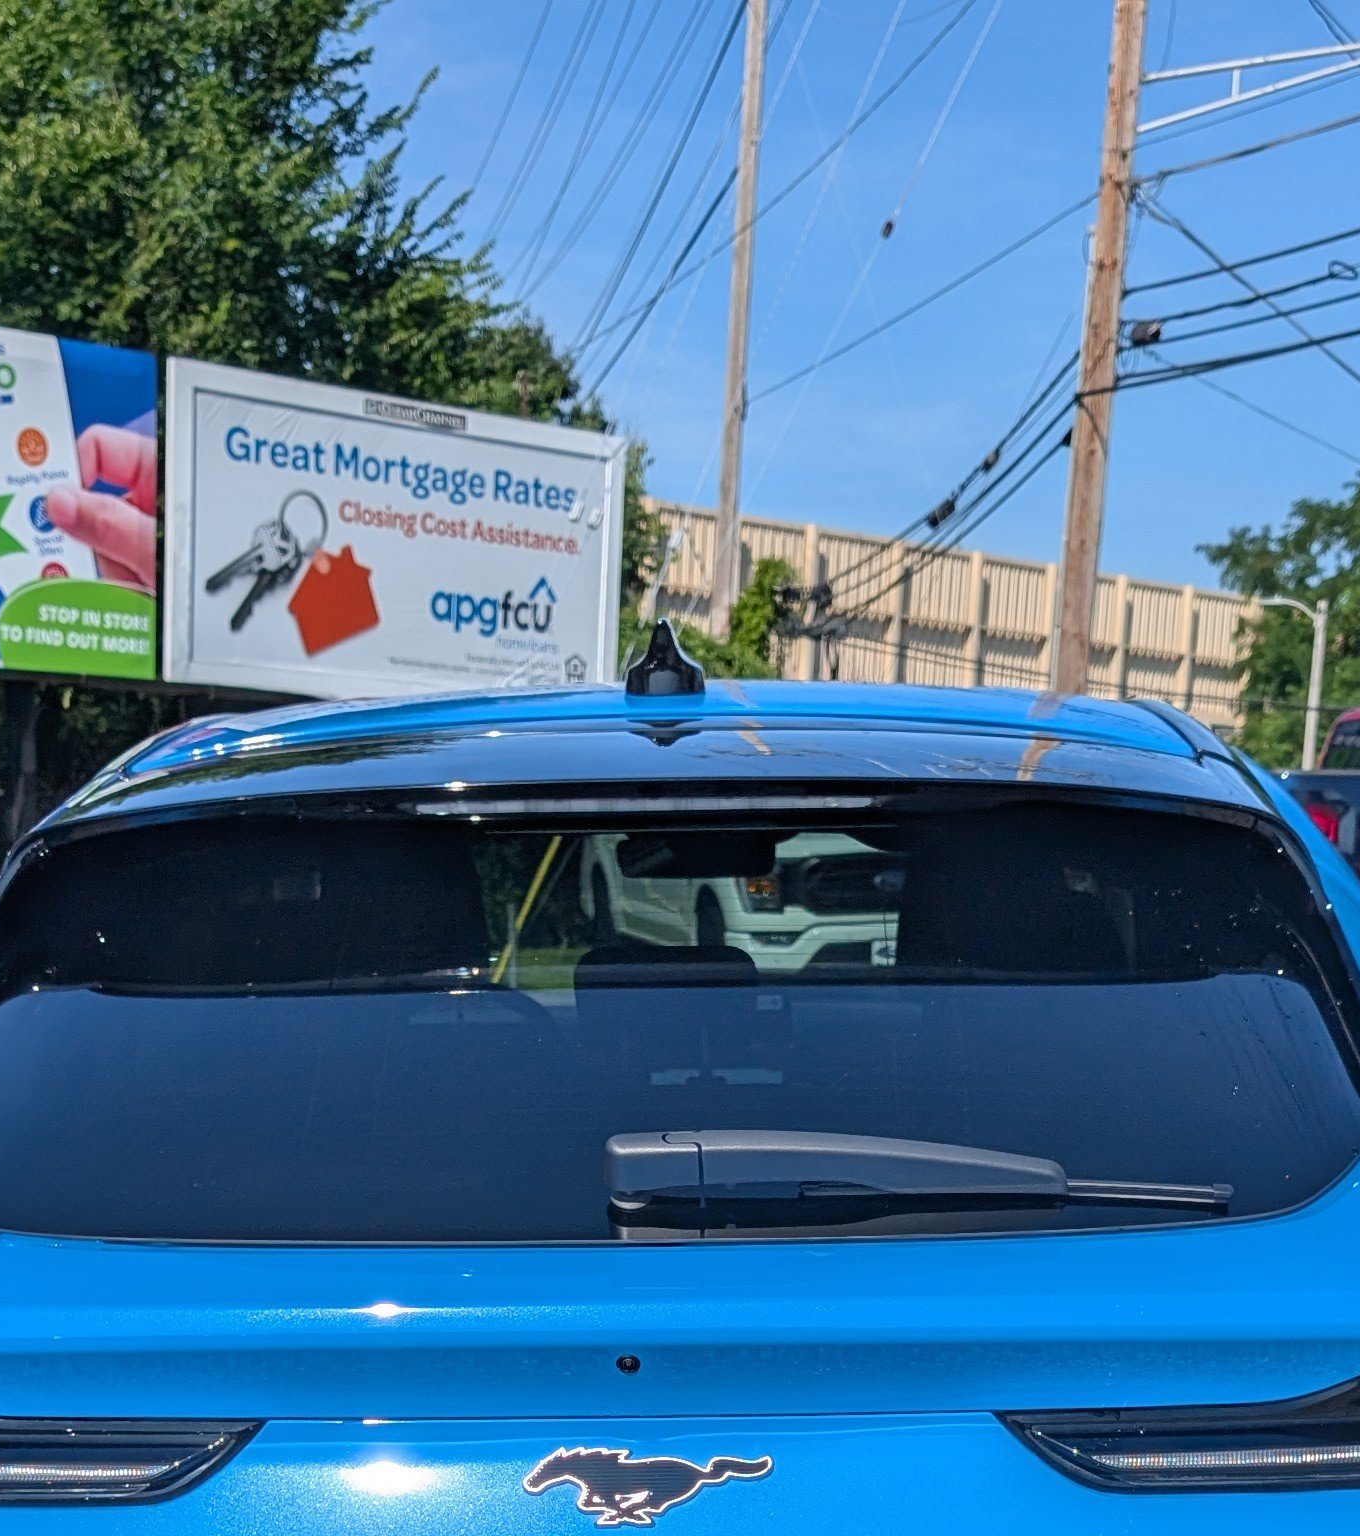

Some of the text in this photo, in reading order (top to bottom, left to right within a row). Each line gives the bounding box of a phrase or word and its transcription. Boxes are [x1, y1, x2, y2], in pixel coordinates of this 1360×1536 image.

[225, 426, 577, 512] Great Mortgage Rates
[338, 499, 582, 555] Closing Cost Assistance.
[0, 624, 23, 643] TO
[25, 627, 64, 647] FIND
[66, 631, 98, 650] OUT
[39, 605, 150, 632] STOP IN STORE
[430, 589, 552, 637] apgfcu
